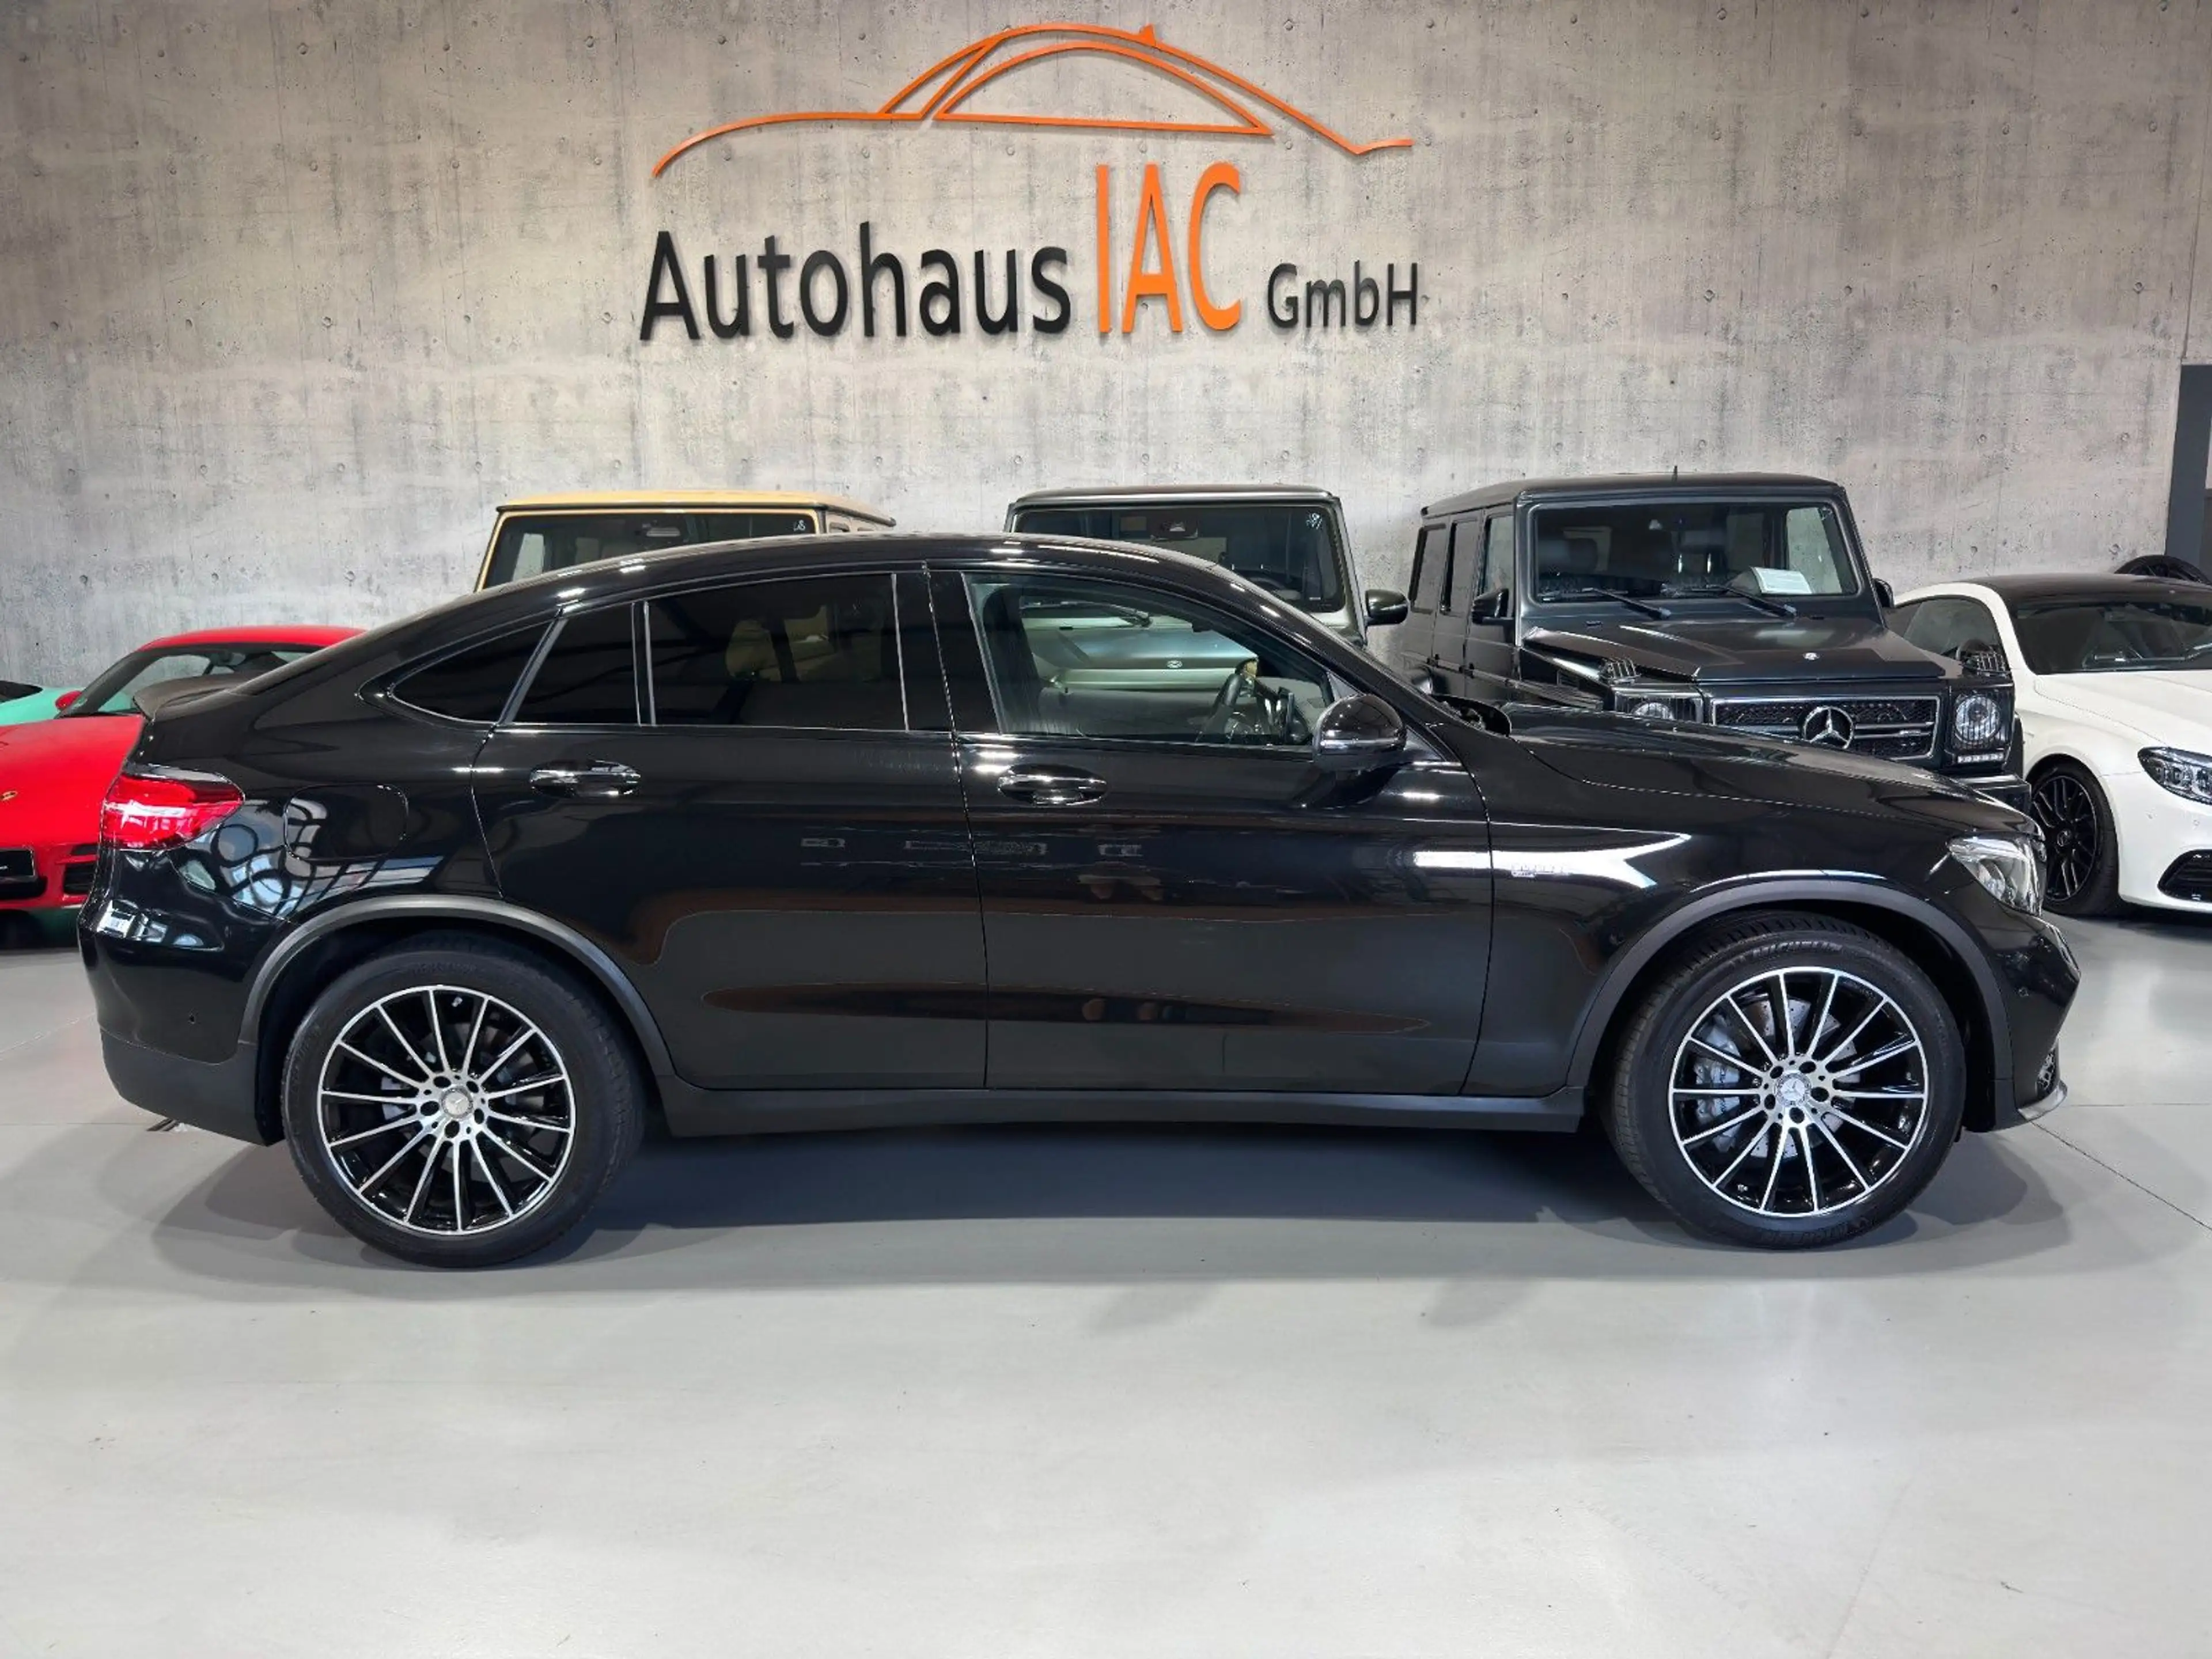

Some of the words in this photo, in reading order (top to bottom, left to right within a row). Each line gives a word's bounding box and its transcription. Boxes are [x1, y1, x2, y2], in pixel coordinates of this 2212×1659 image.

[640, 221, 1071, 341] Autohaus
[1096, 162, 1241, 334] IAC
[1267, 260, 1418, 329] GmbH
